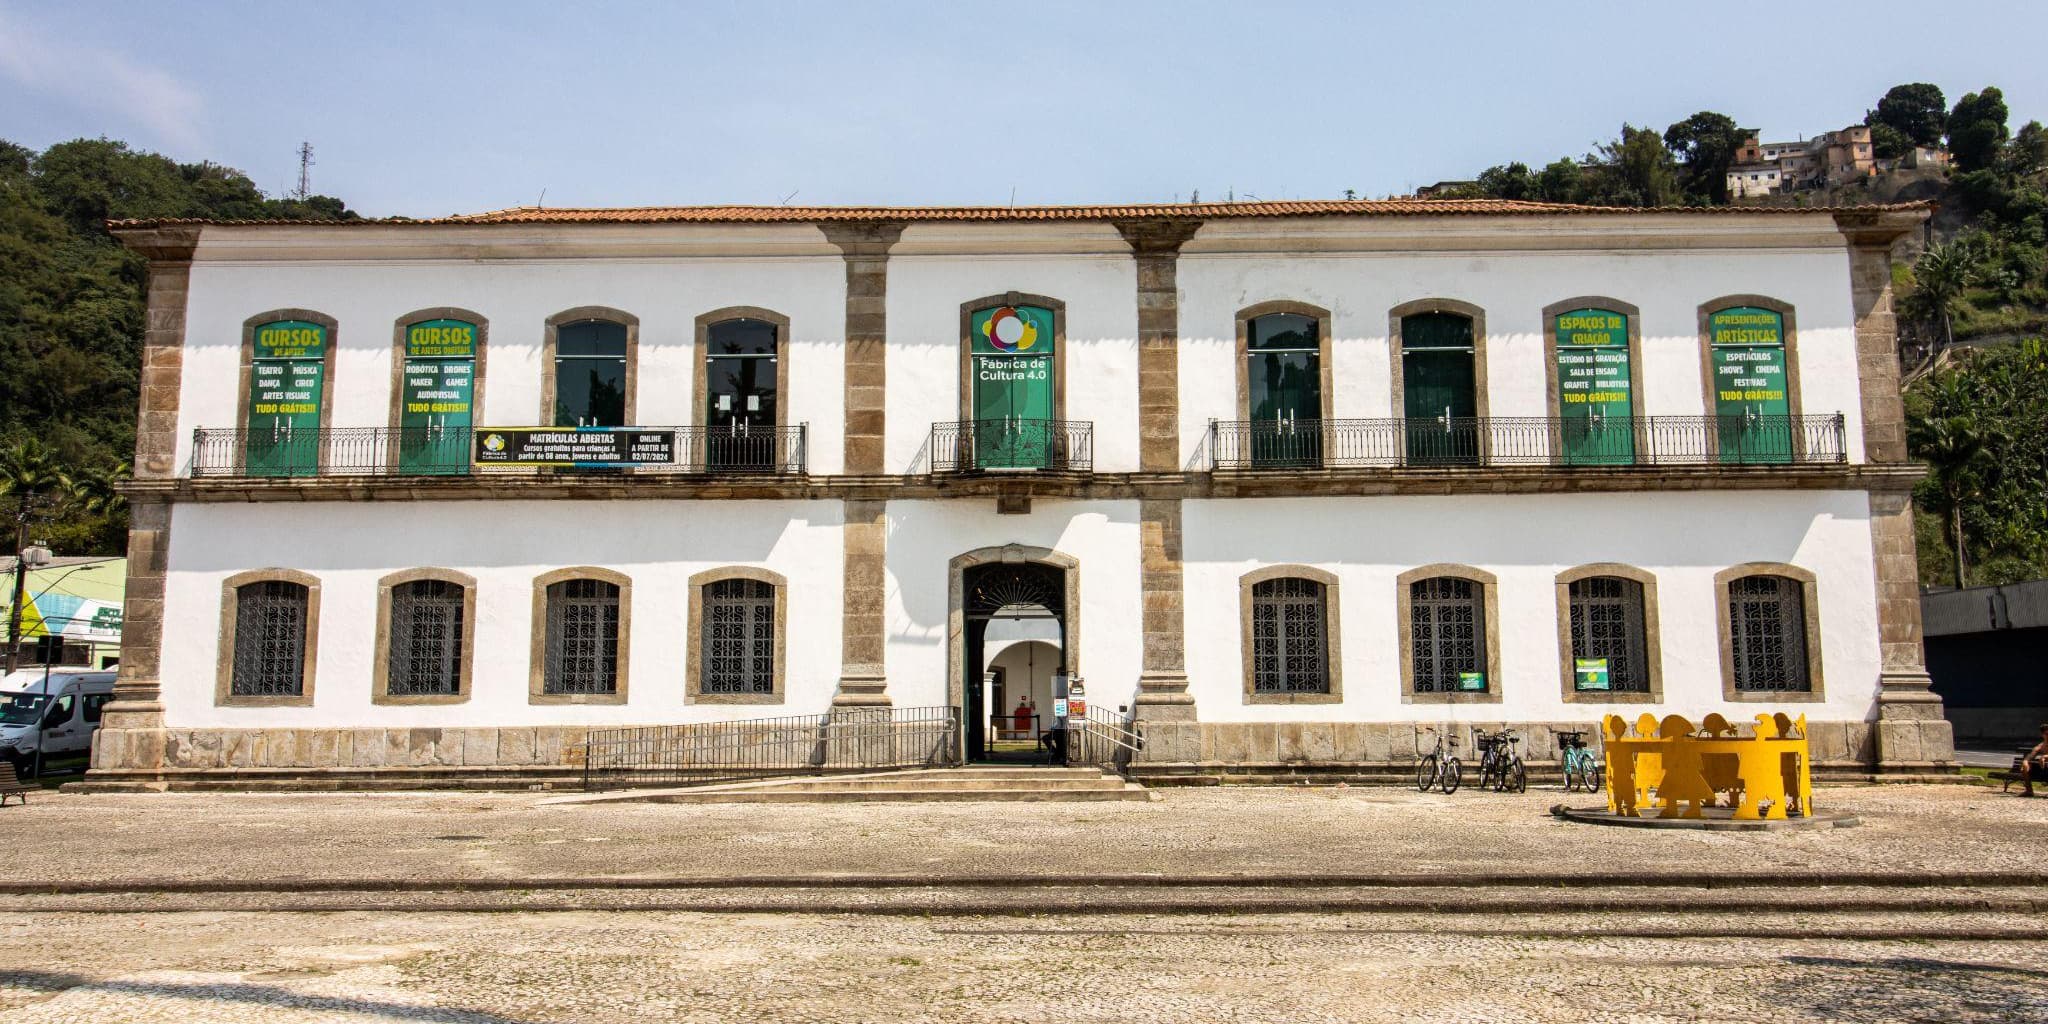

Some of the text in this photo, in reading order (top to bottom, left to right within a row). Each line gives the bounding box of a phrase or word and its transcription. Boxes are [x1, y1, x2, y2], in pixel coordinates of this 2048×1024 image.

[1560, 317, 1622, 331] ESPAÇOS DE
[1715, 314, 1776, 325] APRESENTAÇÕES
[261, 329, 320, 346] CURSOS
[412, 328, 472, 344] CURSOS
[1572, 332, 1610, 346] CRIAÇÃO
[1716, 328, 1777, 342] ARTÍSTICAS
[274, 348, 284, 356] DE
[1726, 352, 1772, 361] ESPETÁCULOS
[982, 359, 1046, 368] Fábrica de
[1559, 355, 1584, 363] ESTÚDIO
[1596, 354, 1627, 364] GRAVAÇÃO
[258, 365, 317, 374] TEATRO MÚSICA
[406, 364, 438, 373] ROBÓTICA
[1570, 368, 1585, 376] SALA
[1586, 368, 1594, 376] DE
[1720, 366, 1744, 374] SHOWS
[980, 371, 1046, 380] Cultura 4.0
[259, 380, 280, 388] DANÇA
[263, 392, 310, 400] ARTES VISUAIS
[1564, 391, 1626, 402] TUDO GRÁTIS!!!
[1720, 390, 1783, 400] TUDO GRÁTIS!!!
[256, 403, 316, 413] TUDO GRÁTIS!!!
[408, 402, 468, 412] TUDO GRÁTIS!!!
[530, 432, 614, 443] MATRÍCULAS ABERTAS
[544, 444, 570, 452] gratuitos
[587, 445, 610, 453] crianças
[518, 452, 536, 460] partir
